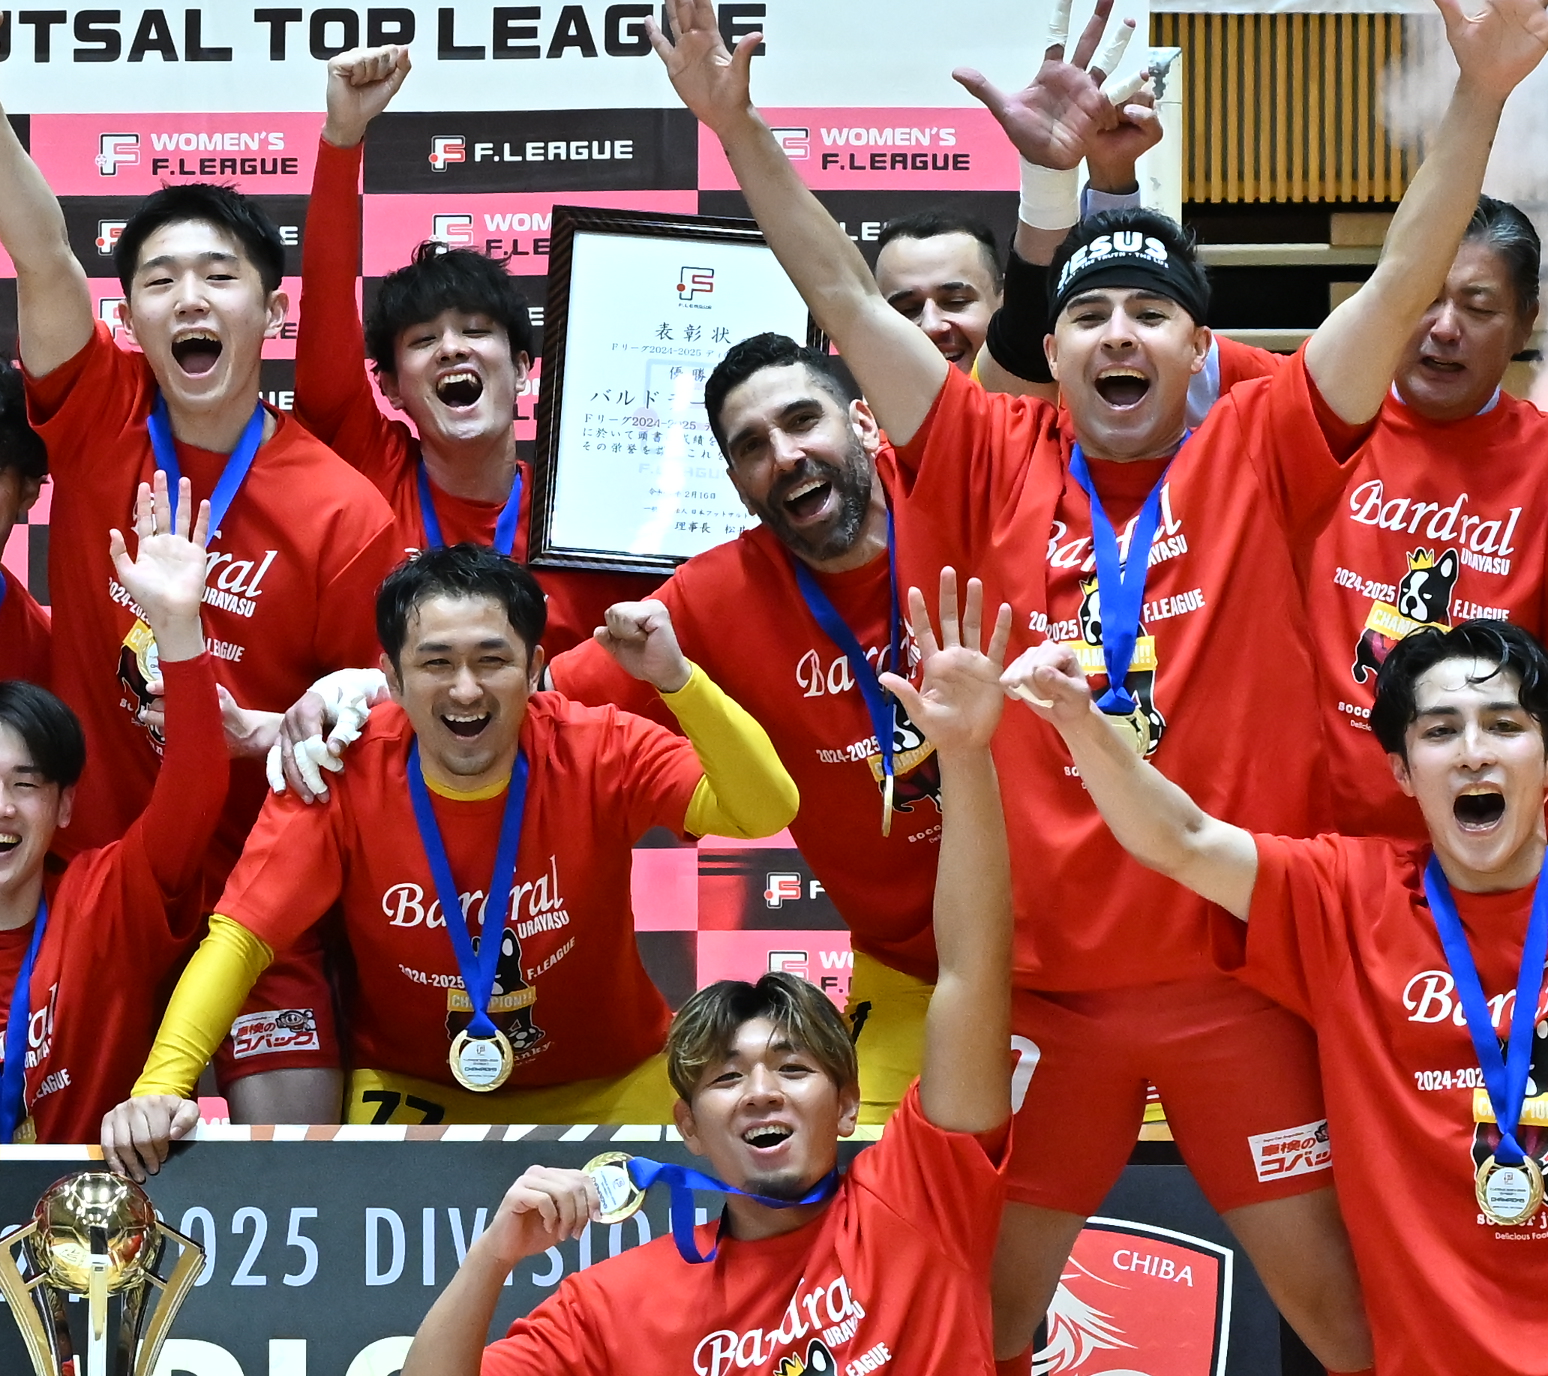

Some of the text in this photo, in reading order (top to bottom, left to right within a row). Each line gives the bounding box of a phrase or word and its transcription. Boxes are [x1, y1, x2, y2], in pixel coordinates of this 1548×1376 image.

[436, 3, 767, 61] LEAGE
[150, 131, 285, 152] WOMEN'S
[473, 139, 634, 162] F.LEAGUE
[820, 127, 957, 147] WOMEN'S
[151, 157, 299, 176] F.LEAGUE
[821, 152, 971, 172] F.LEAGUE
[1057, 230, 1168, 290] JESUS
[654, 321, 732, 344] 表彰状
[1349, 478, 1523, 557] Bardral
[1461, 548, 1511, 576] URAYASU
[1334, 567, 1396, 603] 2024-2025
[1143, 587, 1206, 624] F.LEAGUE
[382, 854, 564, 929] Barral
[516, 909, 570, 939] URAYASU
[526, 936, 576, 981] F.LEAGUE
[1414, 1068, 1486, 1091] 2024-202
[1260, 1150, 1332, 1177] コバッ
[1495, 1231, 1531, 1241] Delicious
[1112, 1248, 1194, 1287] CHIBA
